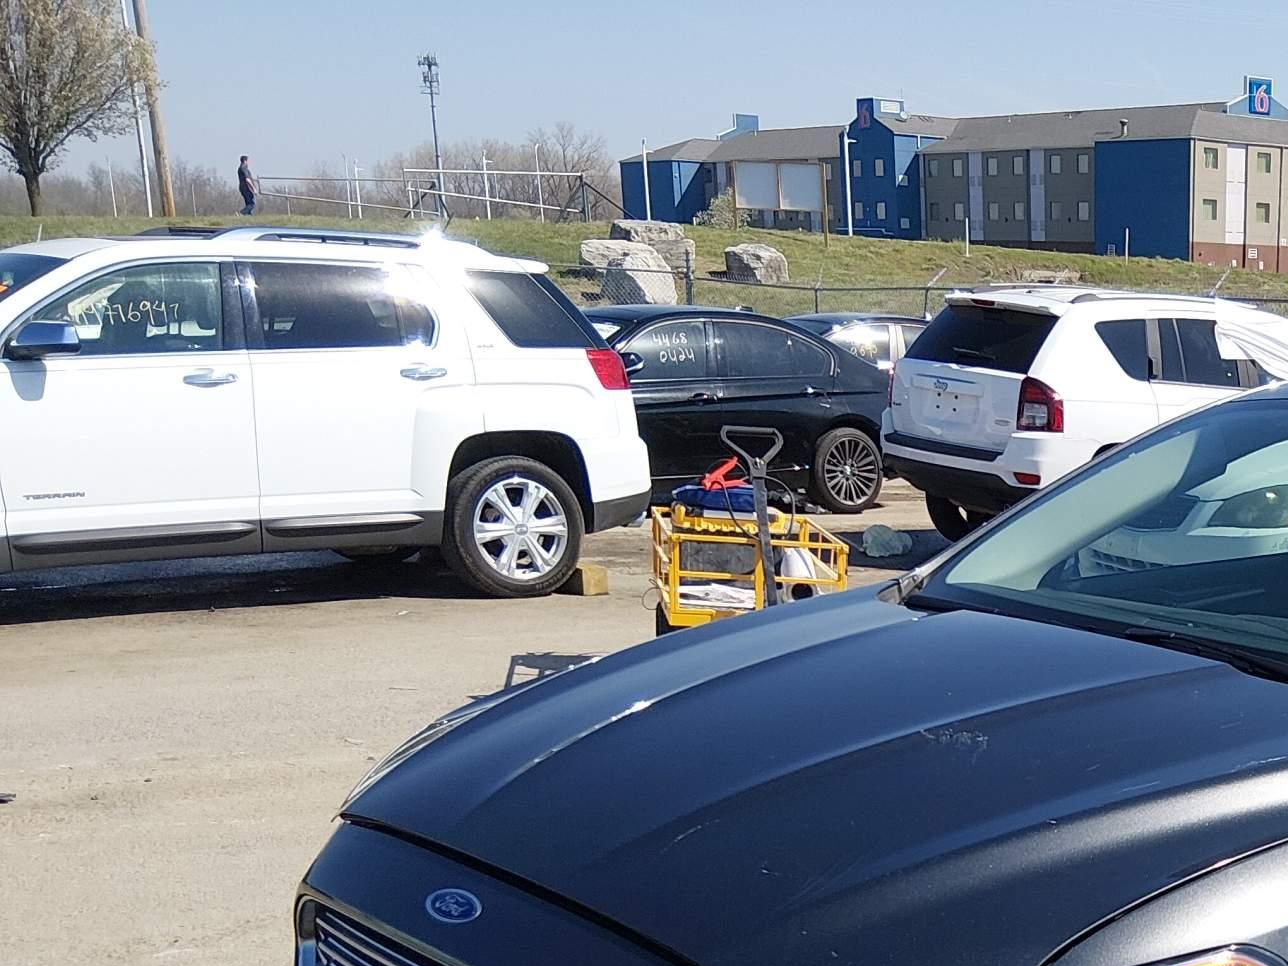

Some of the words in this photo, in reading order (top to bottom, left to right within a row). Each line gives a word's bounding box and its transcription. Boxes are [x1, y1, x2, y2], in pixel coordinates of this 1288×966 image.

[1255, 85, 1269, 113] 6
[652, 332, 688, 347] 4468
[660, 347, 695, 366] 0424
